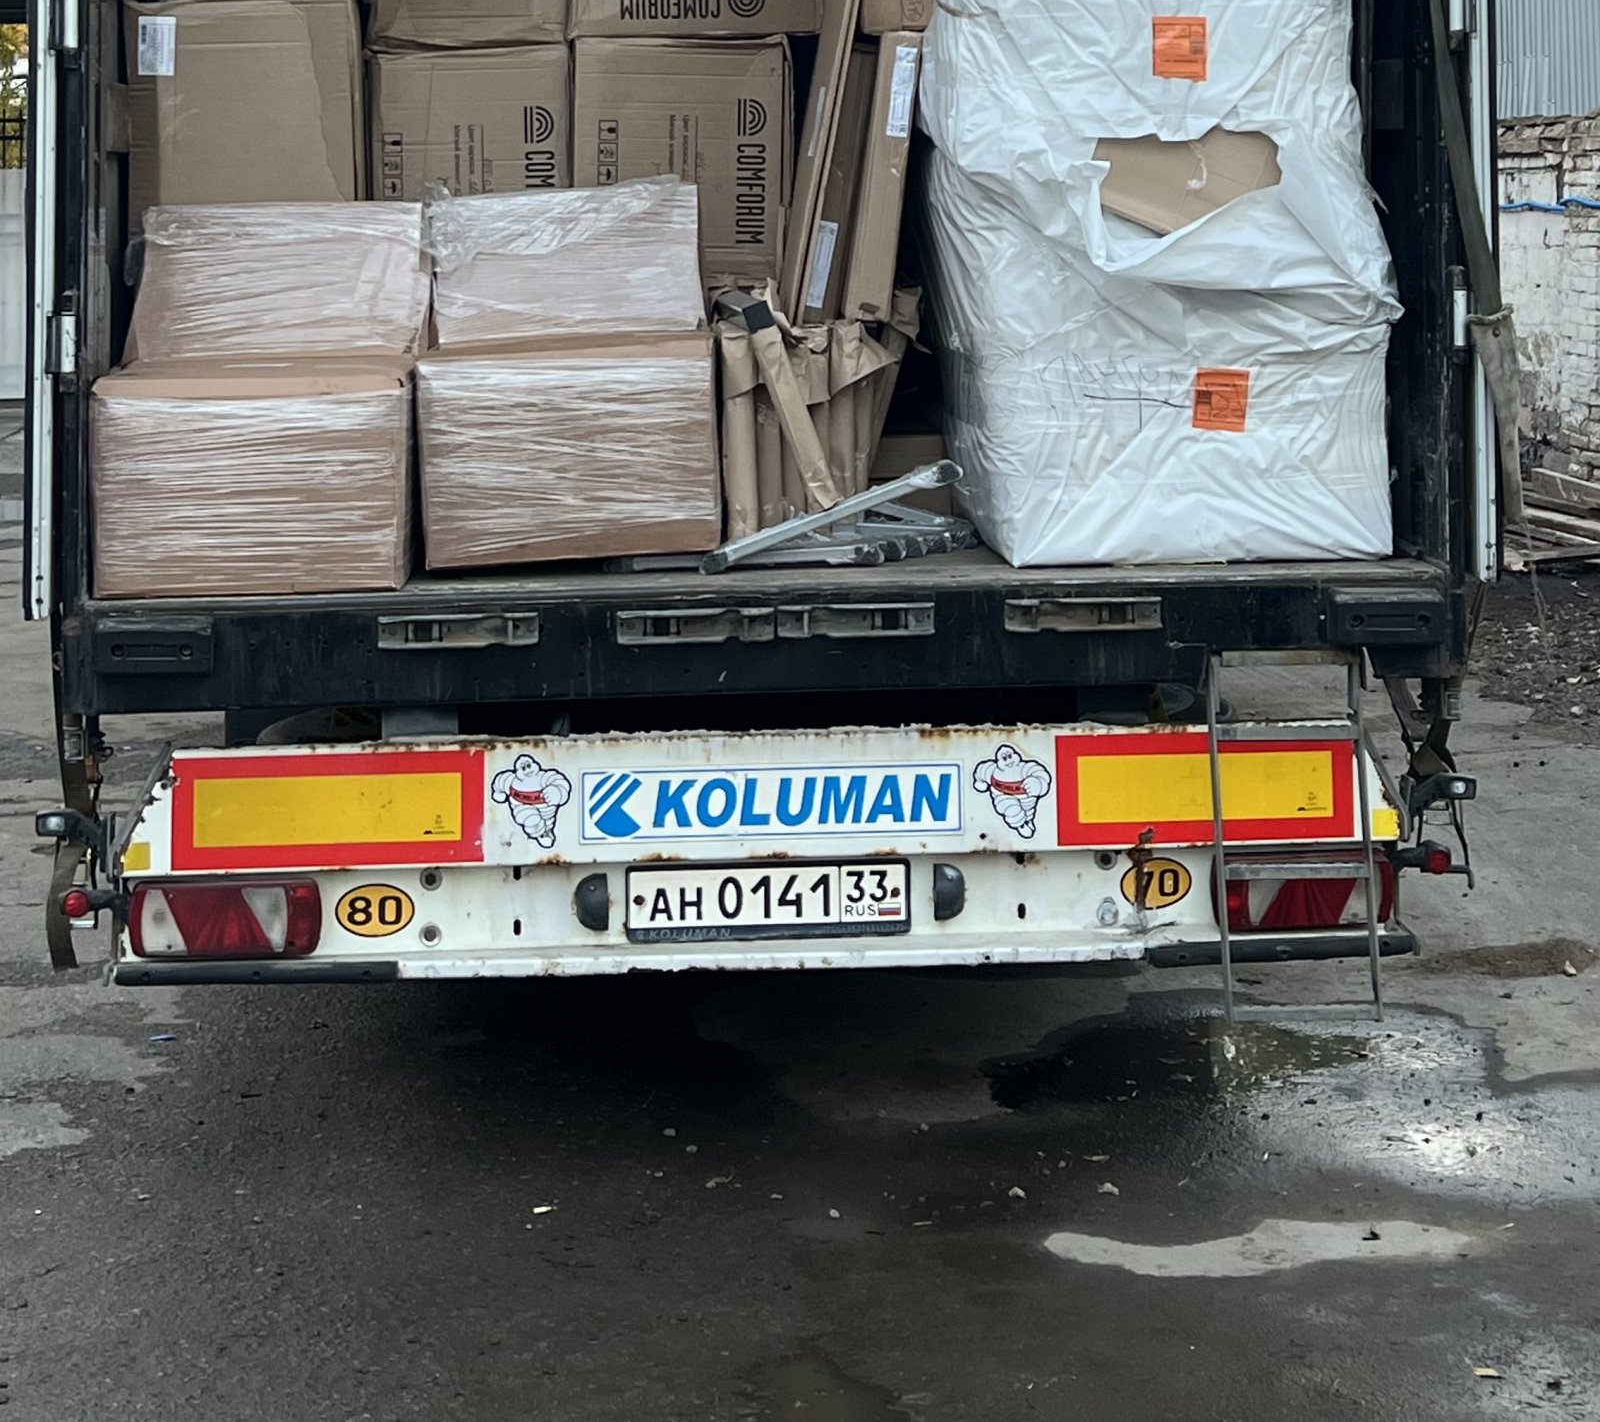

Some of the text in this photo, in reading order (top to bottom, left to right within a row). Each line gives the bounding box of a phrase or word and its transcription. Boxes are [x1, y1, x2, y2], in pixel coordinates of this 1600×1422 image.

[735, 143, 766, 245] COMFORUM
[653, 772, 953, 829] KOLUMAN
[718, 873, 831, 920] 0141
[846, 870, 889, 903] 33
[1140, 868, 1180, 897] 70
[347, 896, 403, 926] 80
[845, 904, 876, 917] RUS
[648, 928, 732, 940] KOLUMAN
